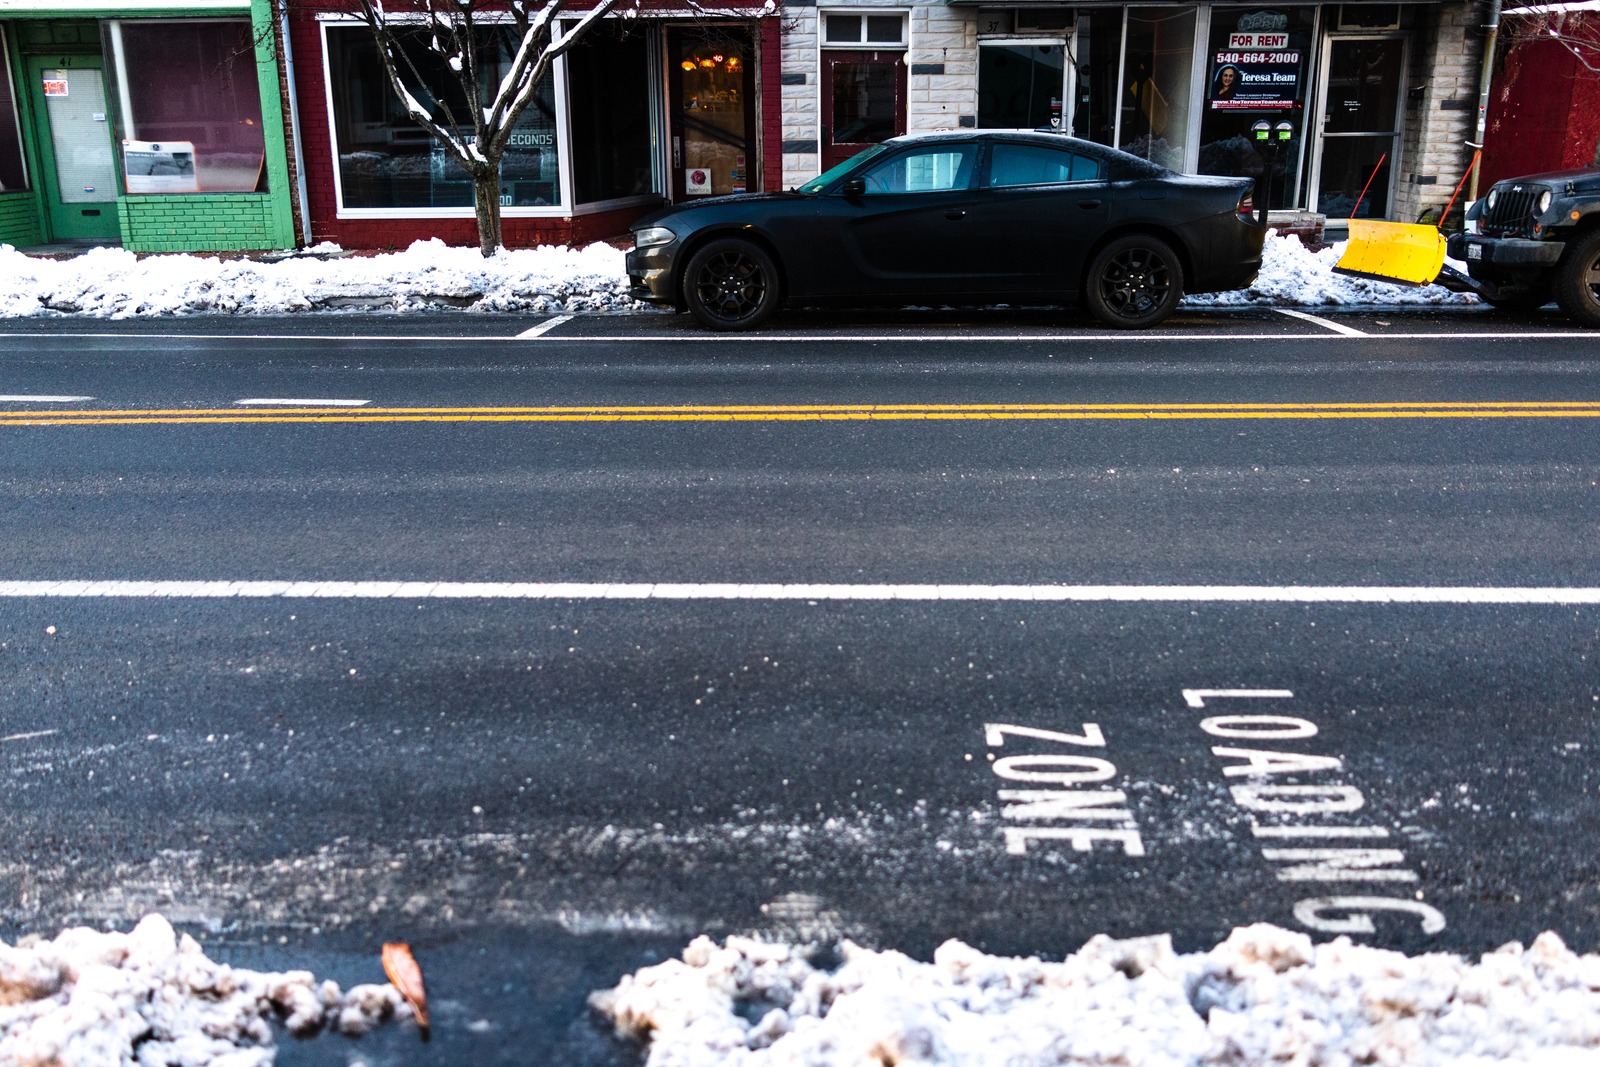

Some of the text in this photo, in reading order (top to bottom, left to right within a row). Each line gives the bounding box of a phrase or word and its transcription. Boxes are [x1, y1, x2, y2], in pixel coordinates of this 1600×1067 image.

[987, 21, 999, 32] 37
[1231, 35, 1286, 46] FOR RENT
[60, 57, 71, 66] 41
[1216, 53, 1299, 63] 540-664-2000
[1241, 73, 1296, 82] Teresa Team
[984, 723, 1145, 856] ZONE
[1182, 689, 1446, 934] LOADING
